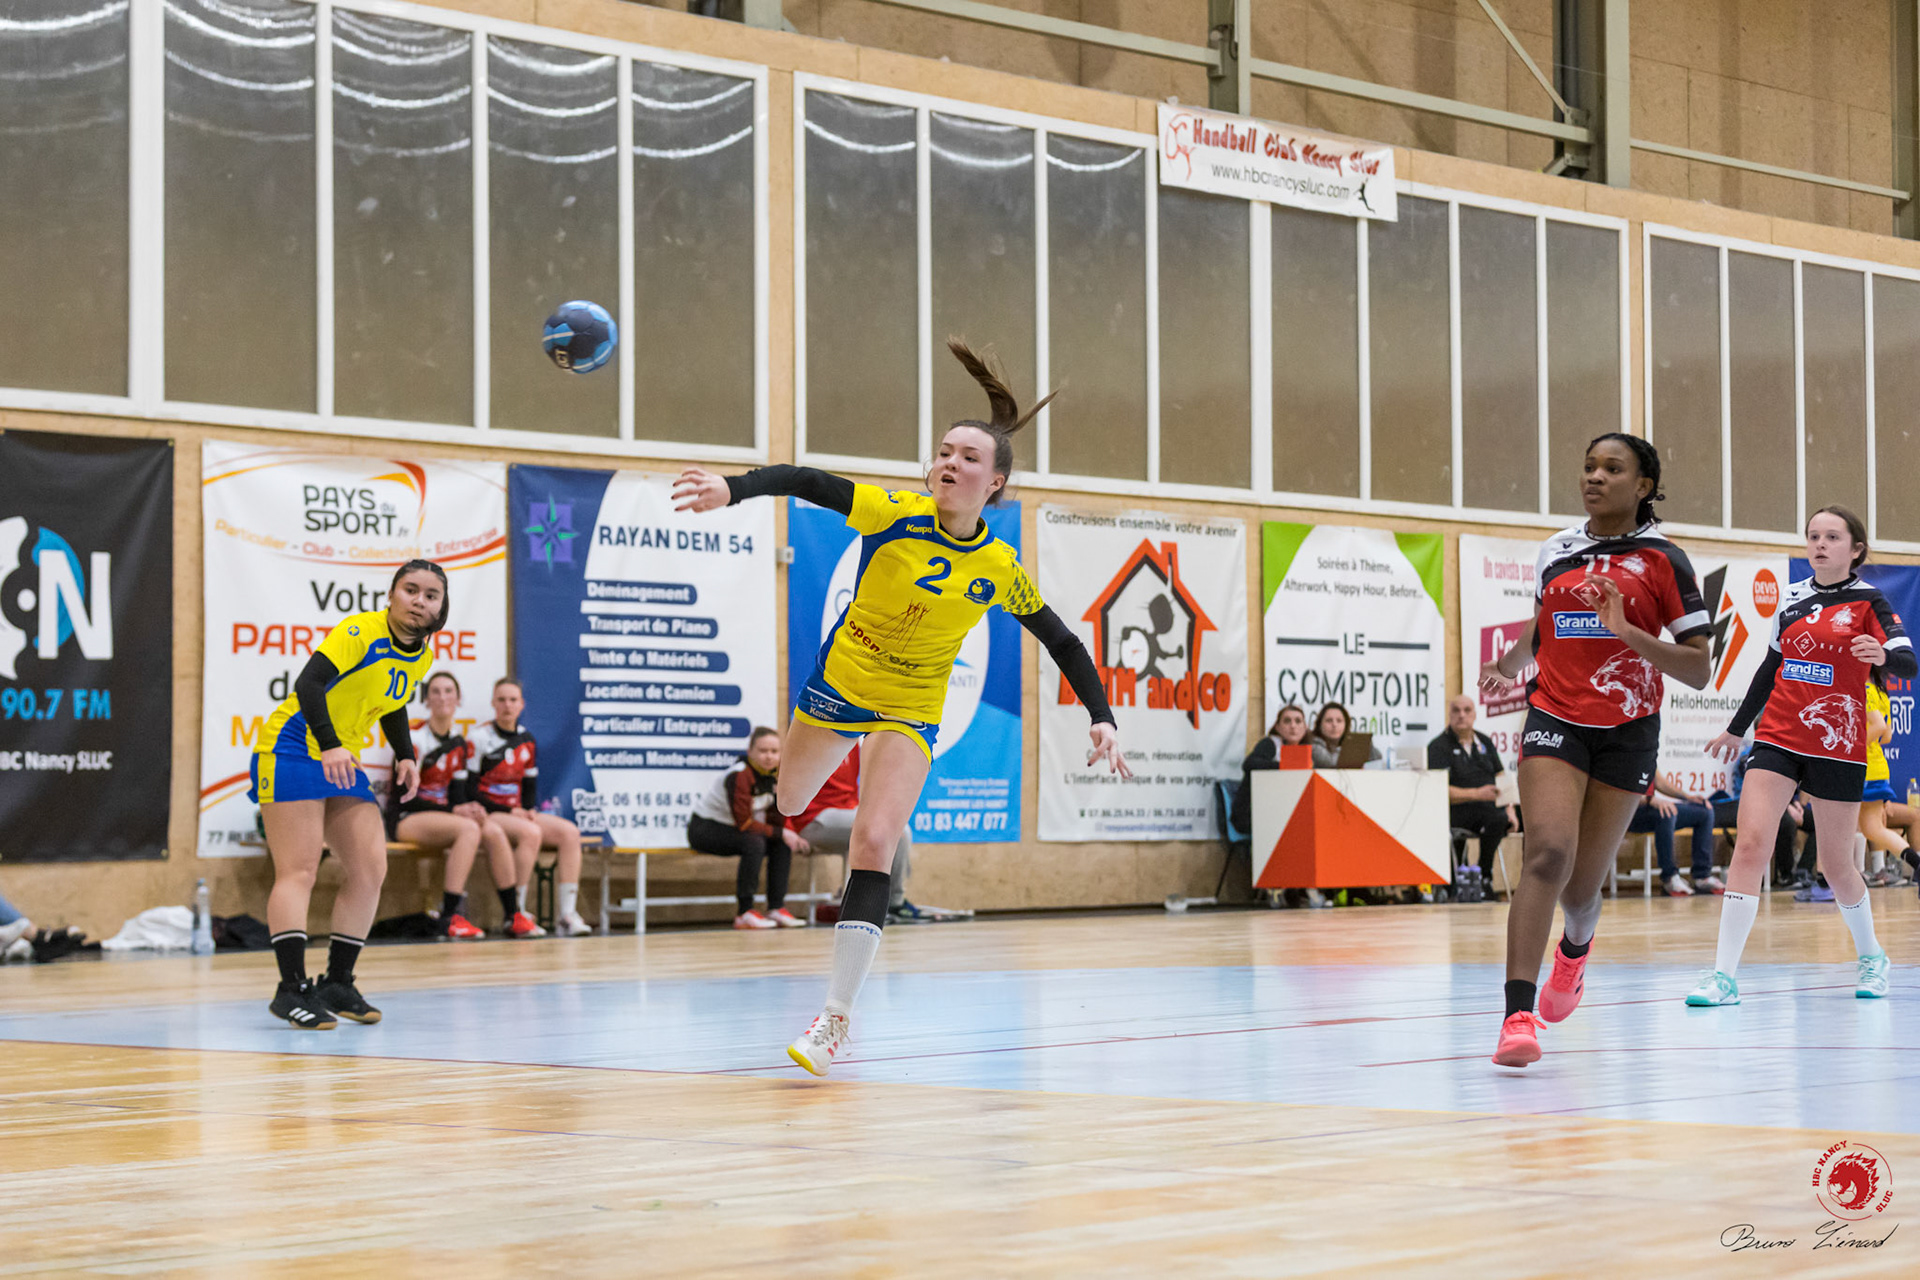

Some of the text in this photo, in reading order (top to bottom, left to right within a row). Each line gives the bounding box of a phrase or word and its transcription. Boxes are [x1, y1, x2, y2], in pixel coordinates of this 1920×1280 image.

[1193, 119, 1257, 154] Handball
[1264, 133, 1297, 162] Club
[1211, 162, 1350, 198] www.hbcnancysluc.com
[303, 484, 375, 511] PAYS
[304, 509, 397, 536] SPORT
[905, 524, 933, 535] Kempa
[1045, 511, 1237, 538] Construisons ensemble votre avenir
[303, 541, 335, 557] Club
[599, 526, 754, 555] RAYAN DEM 54
[1317, 557, 1349, 571] Soirées
[914, 556, 952, 596] 2
[311, 581, 388, 613] Votr
[1334, 582, 1361, 598] Happy
[1755, 581, 1777, 594] DEVIS
[1556, 615, 1598, 629] Grand
[1806, 603, 1823, 625] 3
[588, 615, 711, 636] Transport de Piano
[1343, 633, 1365, 655] LE
[588, 650, 626, 666] Vente
[628, 650, 645, 667] de
[384, 667, 408, 700] 10
[585, 684, 716, 702] Location de Camion
[1278, 668, 1429, 708] COMPTOIR
[1, 688, 111, 720] 90.7 FM
[583, 717, 656, 733] Particulier
[664, 718, 732, 737] Entreprise
[0, 750, 113, 775] BC Nancy SLUC
[585, 751, 644, 766] Location
[1155, 774, 1166, 785] de
[1170, 776, 1184, 785] vos
[1689, 772, 1705, 792] 21
[1711, 772, 1726, 792] 48
[613, 793, 630, 806] 06
[636, 793, 650, 806] 16
[676, 793, 691, 806] 45
[609, 815, 626, 828] 03
[632, 815, 647, 828] 54
[654, 815, 668, 828] 16
[915, 812, 1008, 831] 03 83 447 077
